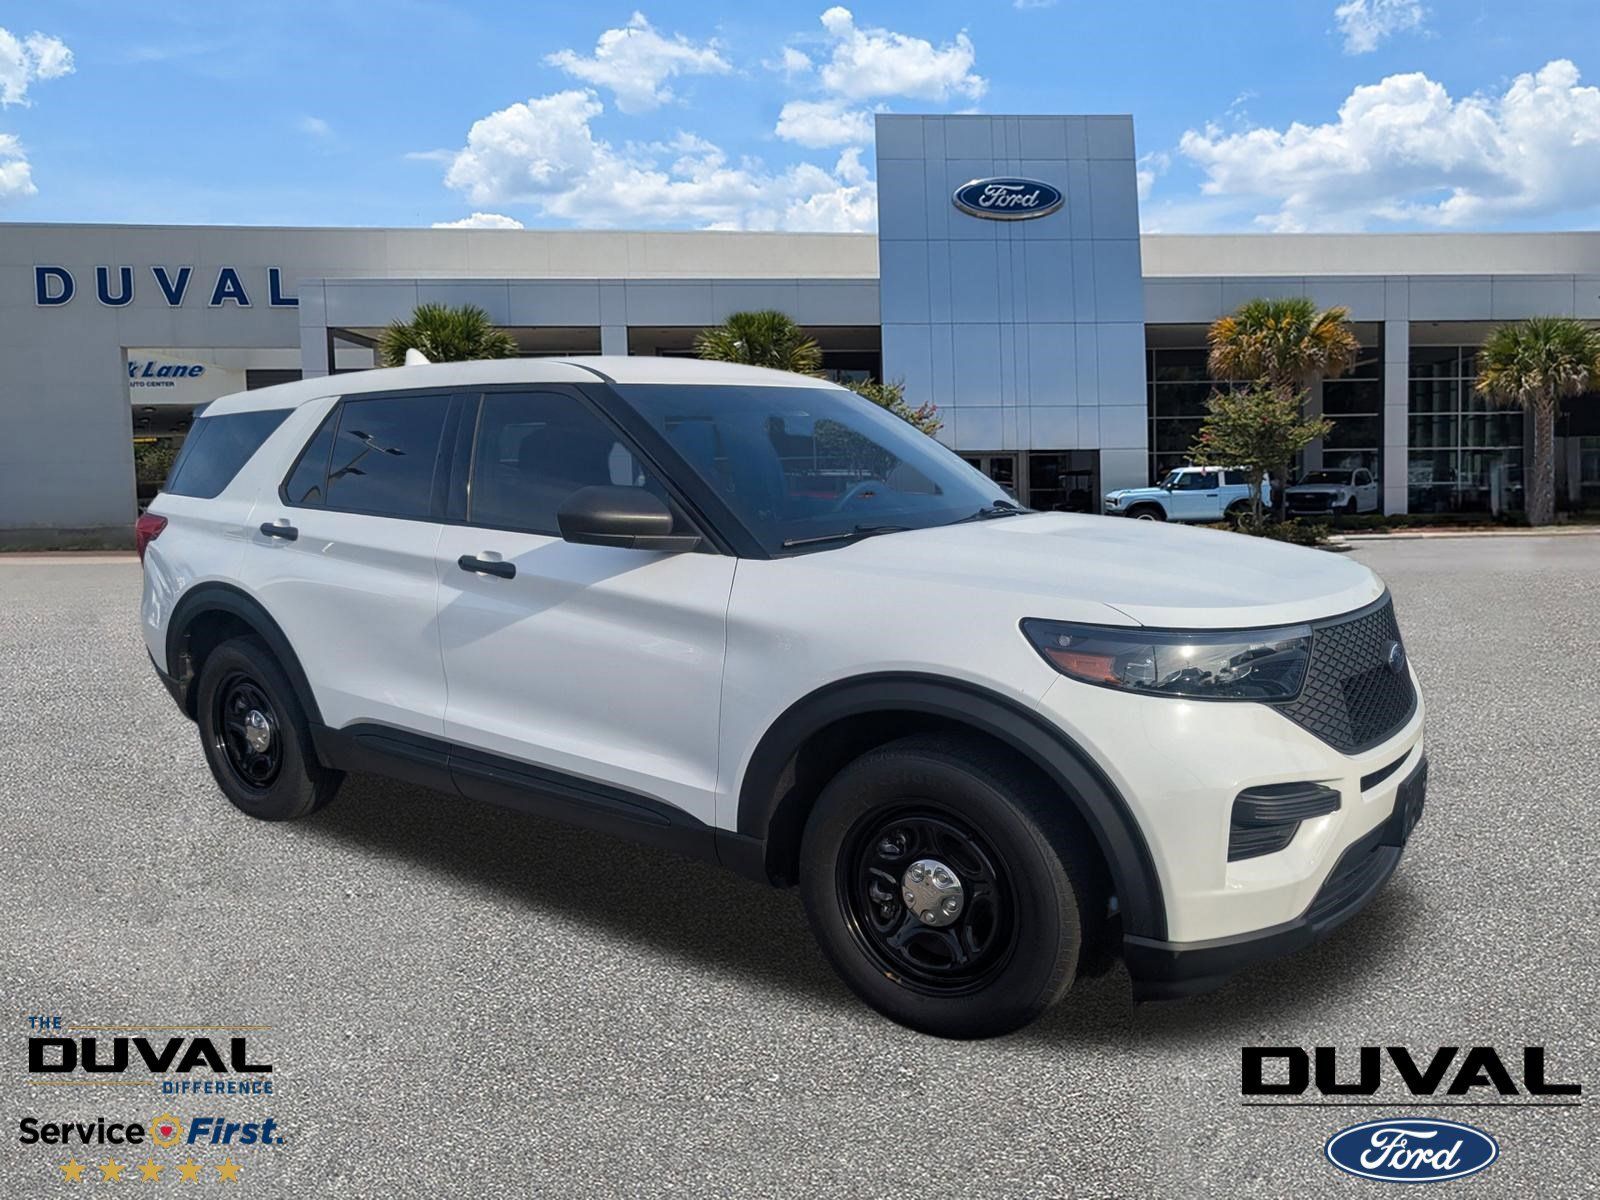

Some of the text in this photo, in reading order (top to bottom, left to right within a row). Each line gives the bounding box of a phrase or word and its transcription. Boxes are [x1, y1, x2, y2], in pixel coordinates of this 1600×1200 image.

[979, 184, 1040, 207] Ford
[34, 266, 299, 307] DUVAL
[142, 361, 205, 378] Lane
